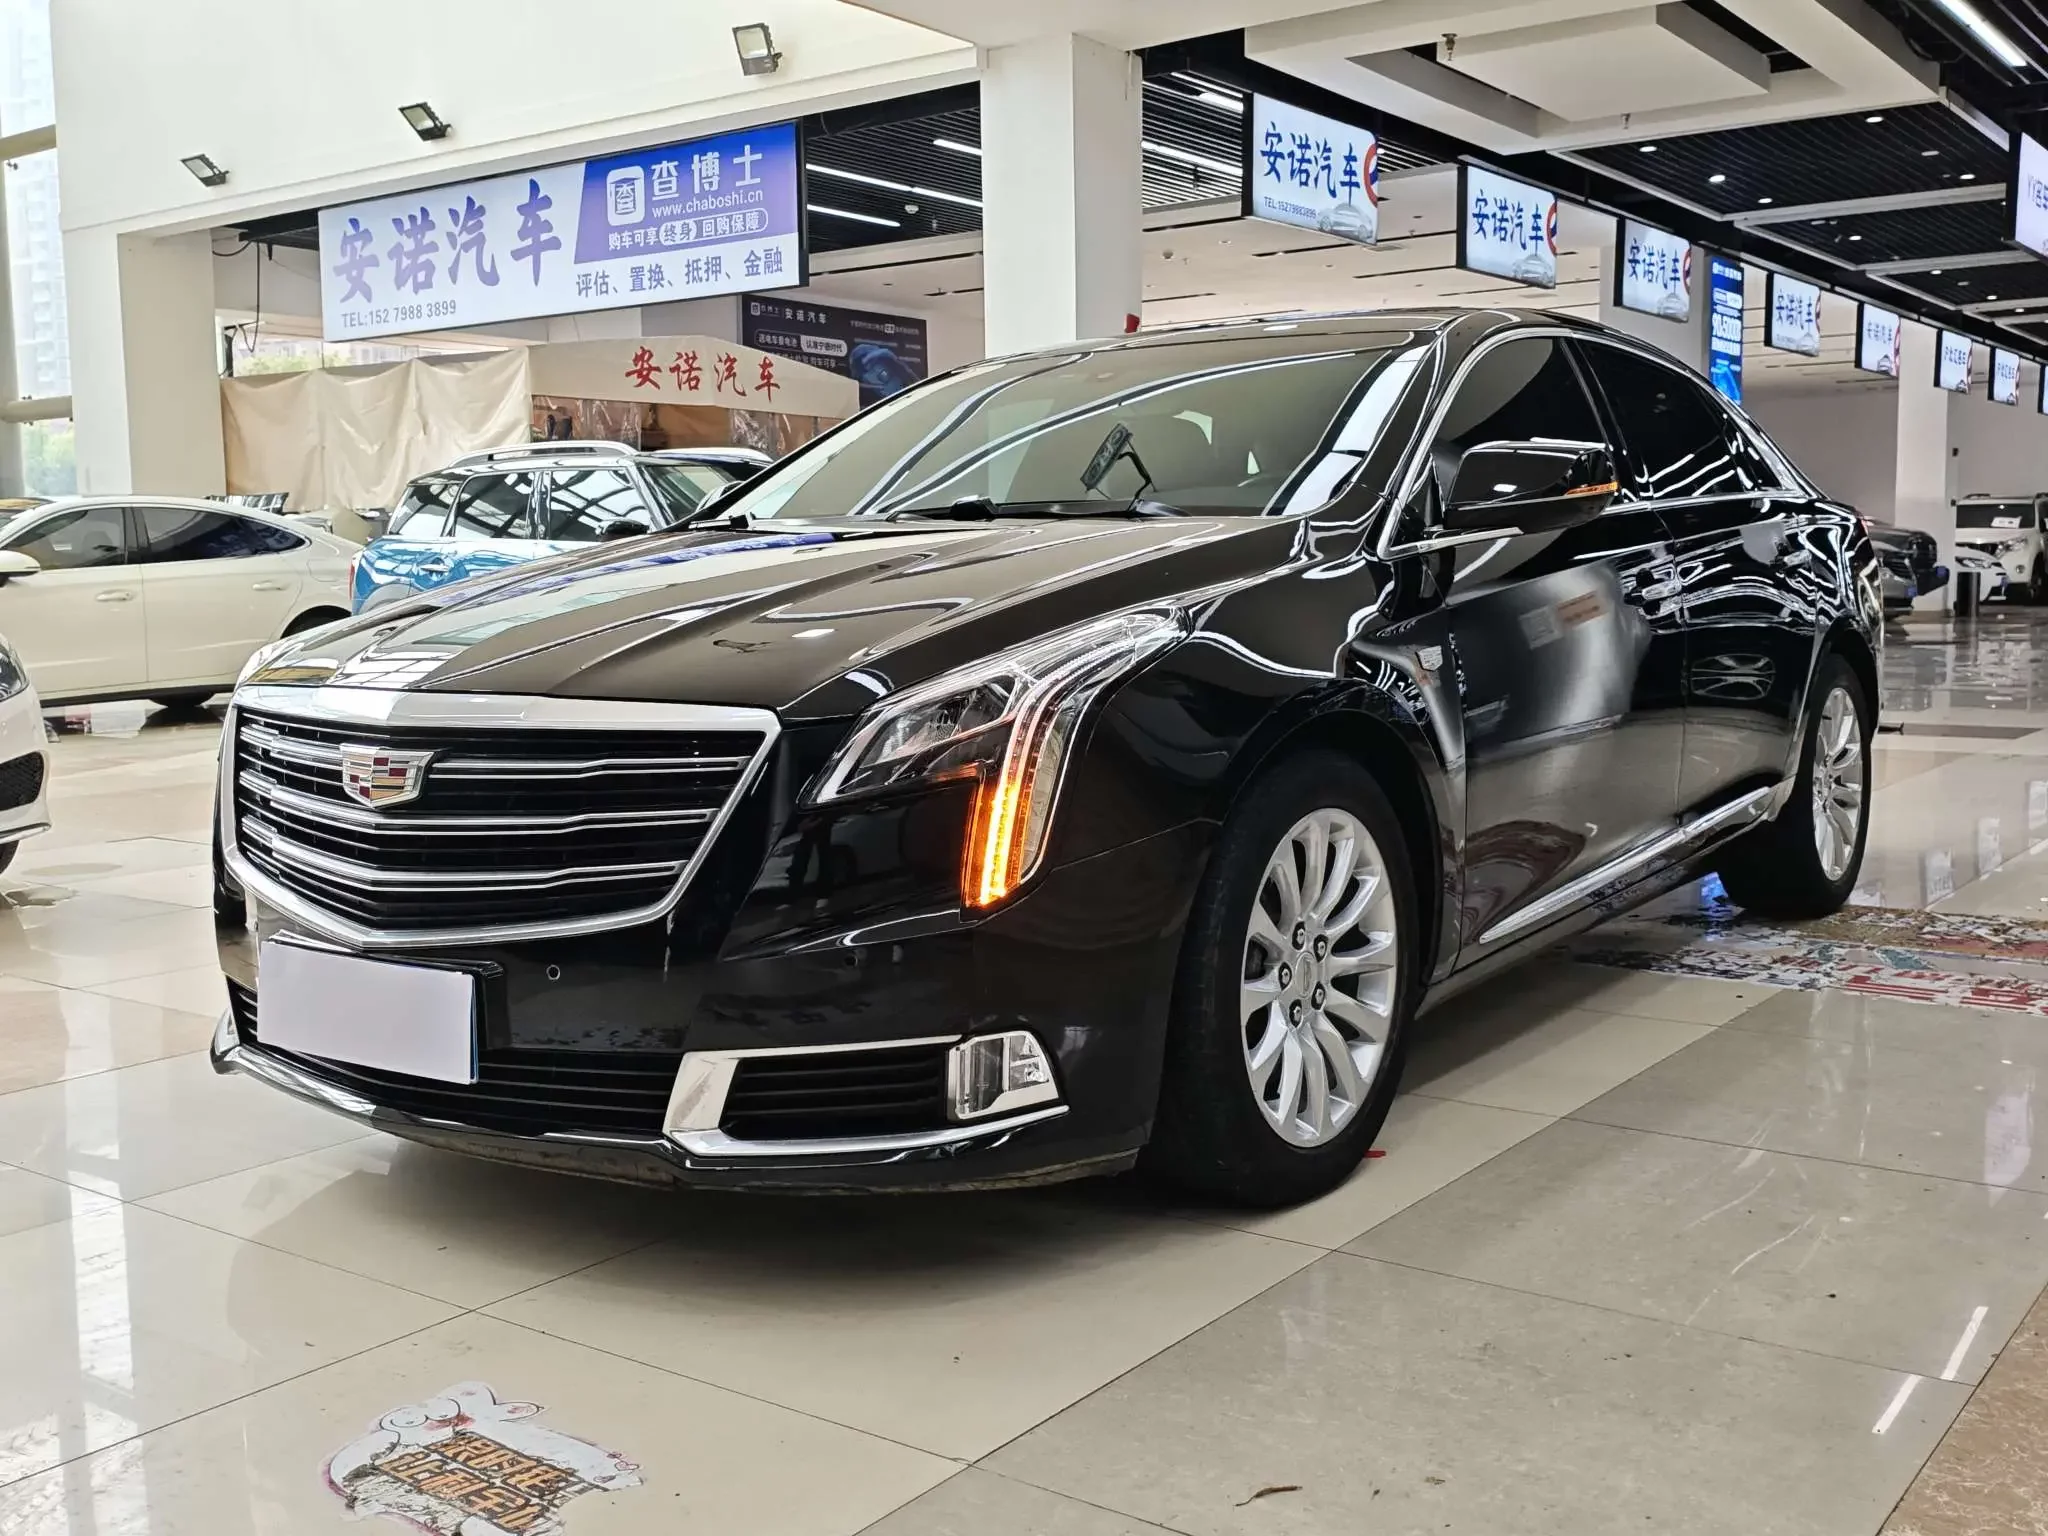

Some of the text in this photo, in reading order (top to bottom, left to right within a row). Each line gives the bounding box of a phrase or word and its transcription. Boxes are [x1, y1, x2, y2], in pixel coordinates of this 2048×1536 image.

[651, 144, 763, 201] 查博士
[1260, 121, 1361, 205] 安诺汽车
[651, 189, 764, 218] www.chaboshi.cn
[1471, 189, 1544, 256] 安诺汽车
[332, 177, 562, 304] 安诺汽车
[1627, 237, 1681, 294] 安诺汽车
[341, 300, 457, 329] TEL:152 7988 3899
[624, 345, 781, 403] 安诺汽车
